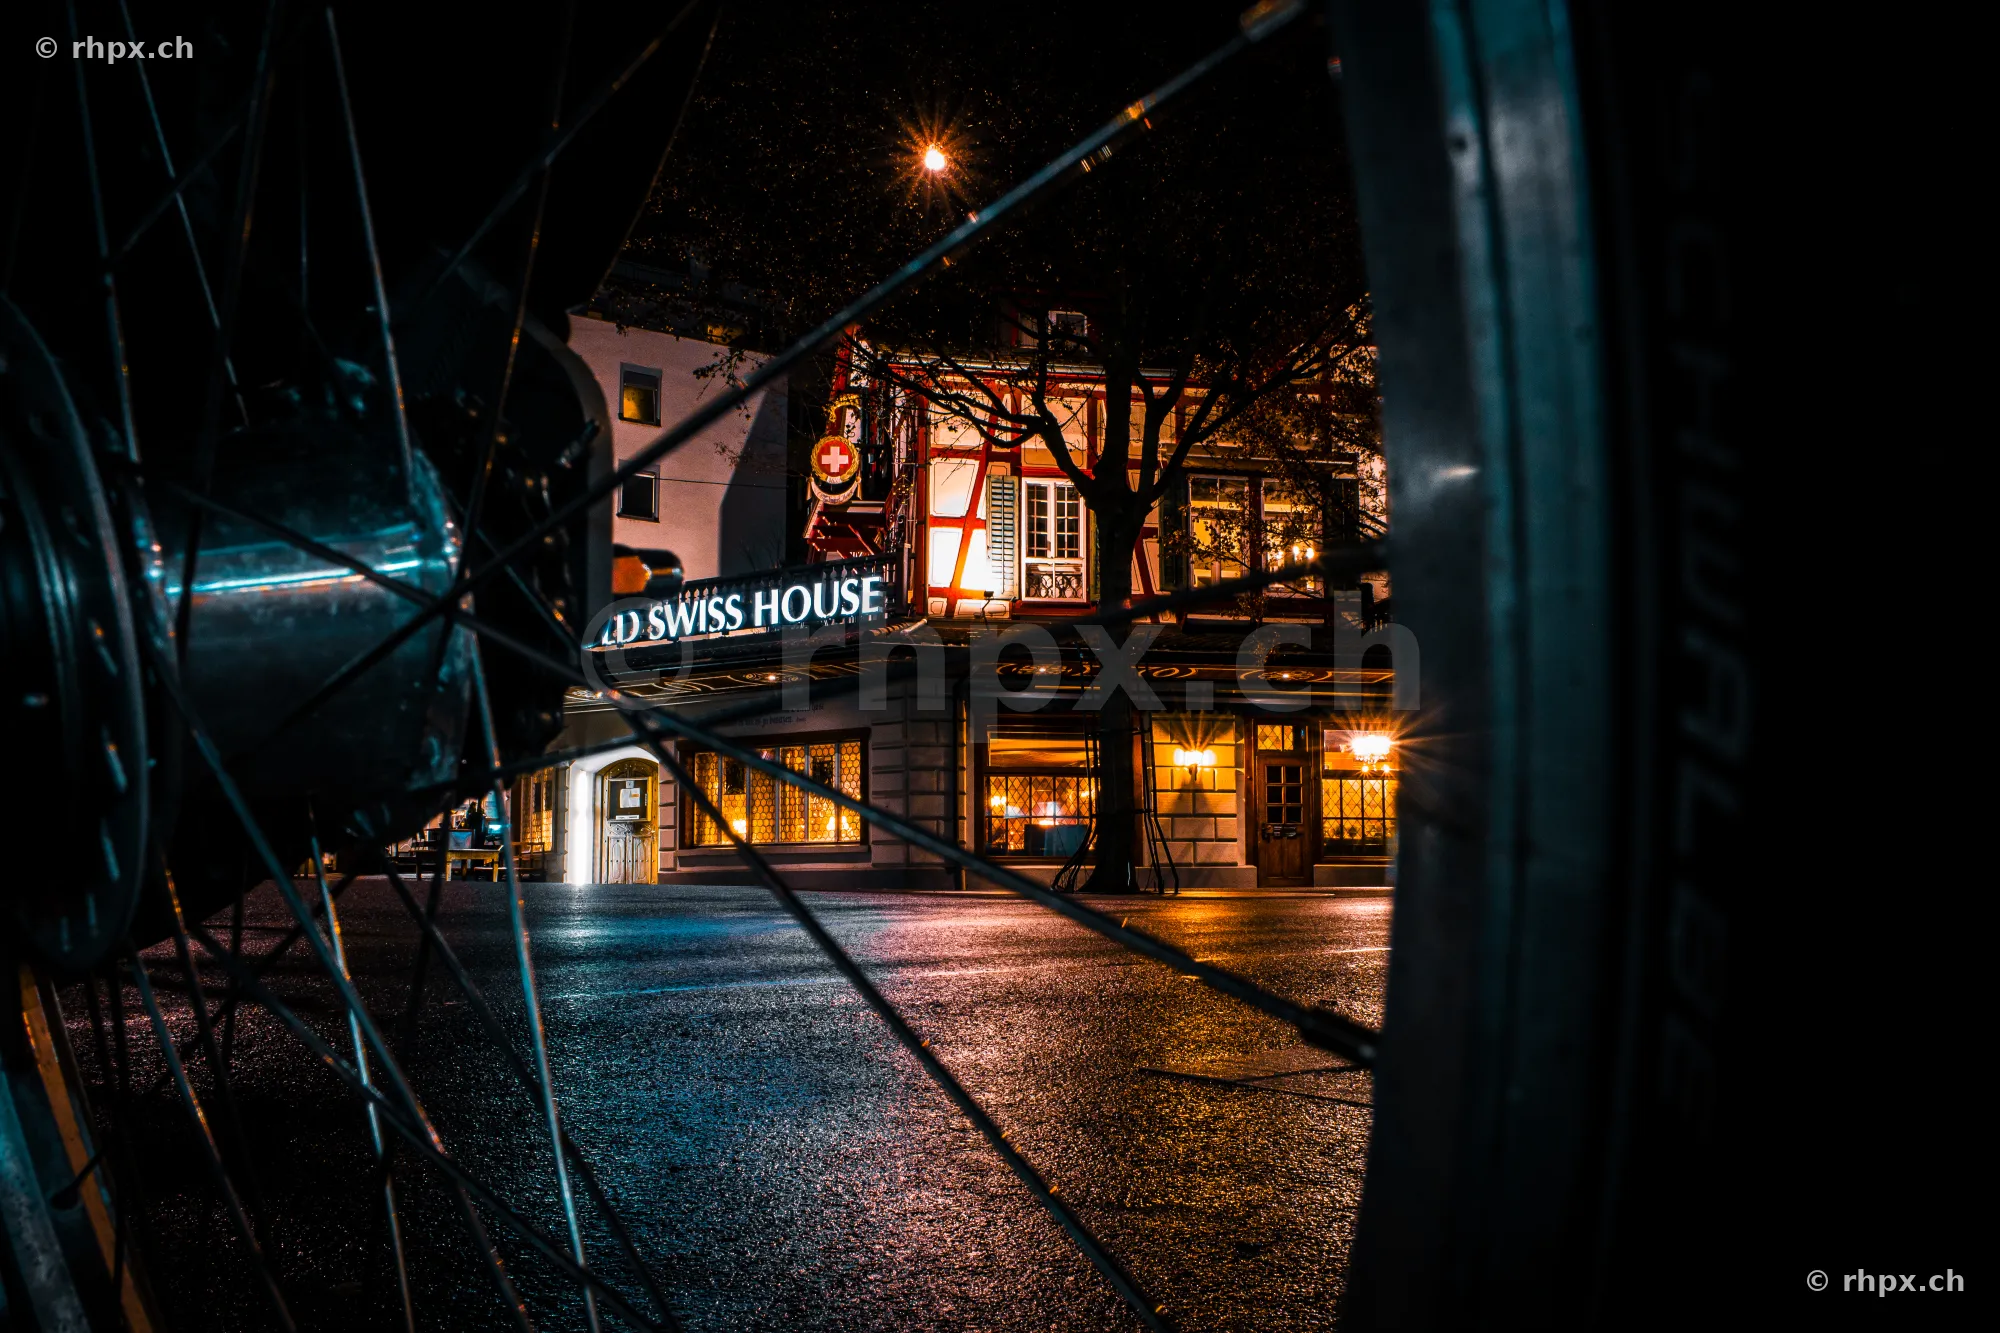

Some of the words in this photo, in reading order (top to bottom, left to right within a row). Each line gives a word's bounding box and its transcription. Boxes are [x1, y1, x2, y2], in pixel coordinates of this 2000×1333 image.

[594, 611, 640, 648] LD
[649, 594, 743, 640] SWISS
[754, 576, 883, 627] HOUSE
[1655, 66, 1758, 1138] SCHWALBE
